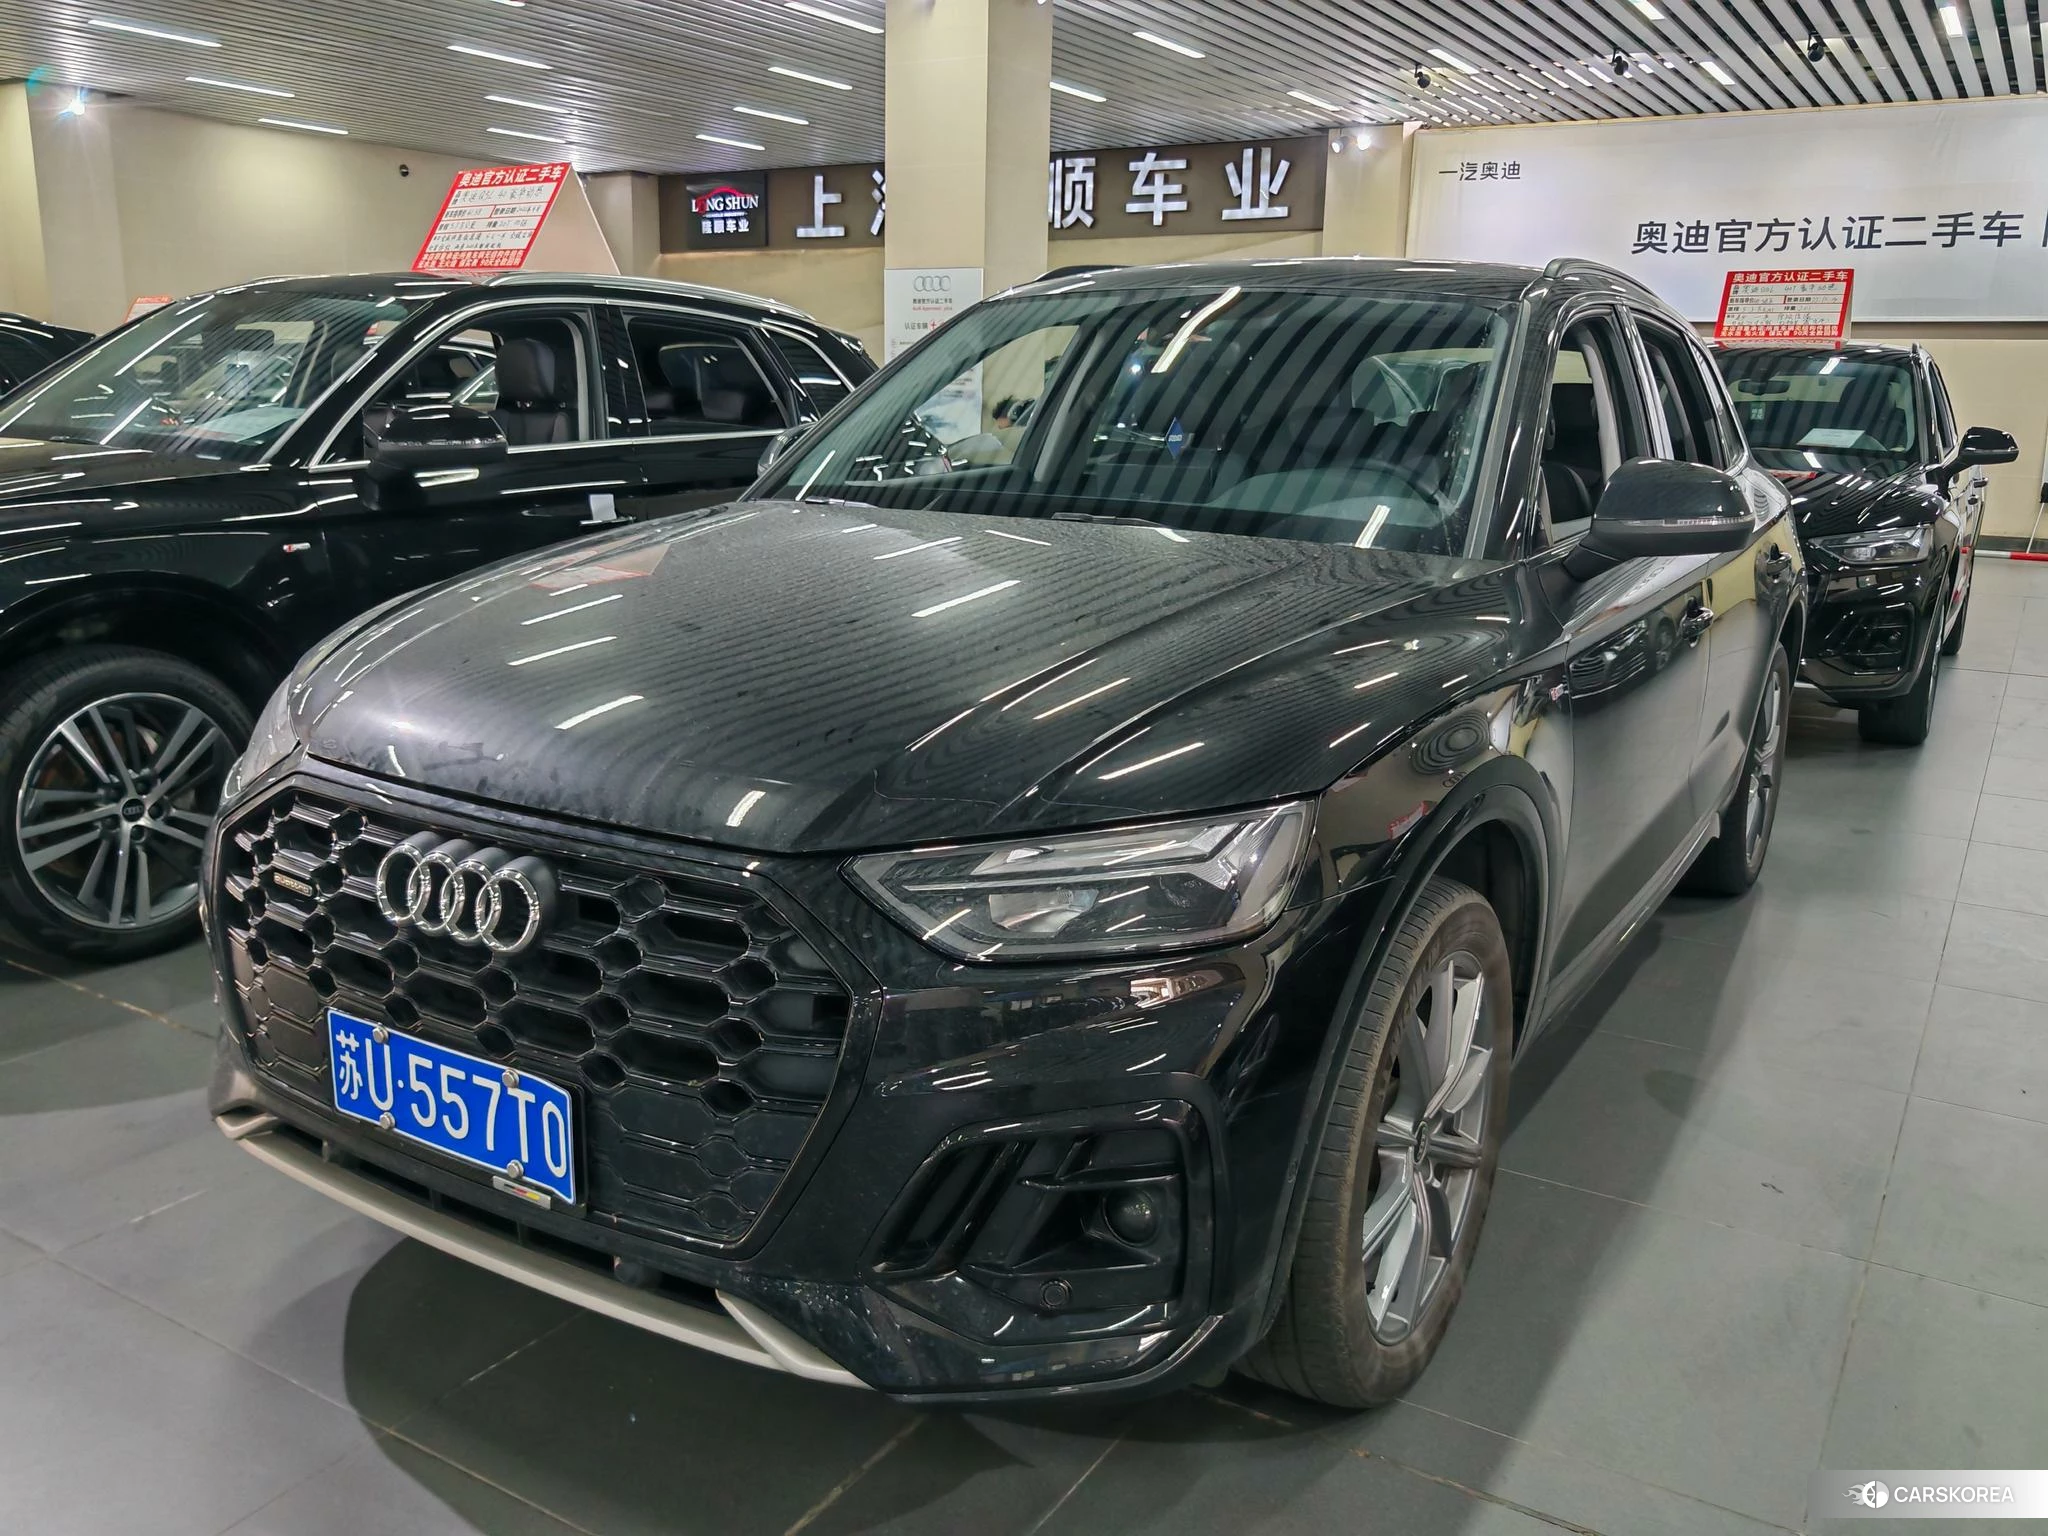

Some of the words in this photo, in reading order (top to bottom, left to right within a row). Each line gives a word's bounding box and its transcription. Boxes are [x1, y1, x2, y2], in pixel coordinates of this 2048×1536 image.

[459, 165, 564, 187] 奥迪官方认证二手车
[1438, 160, 1521, 181] 一汽奥迪
[725, 195, 759, 210] SHUN
[1631, 210, 2025, 254] 奥迪官方认证二手车
[1732, 271, 1849, 283] 奥迪官方认证二手车
